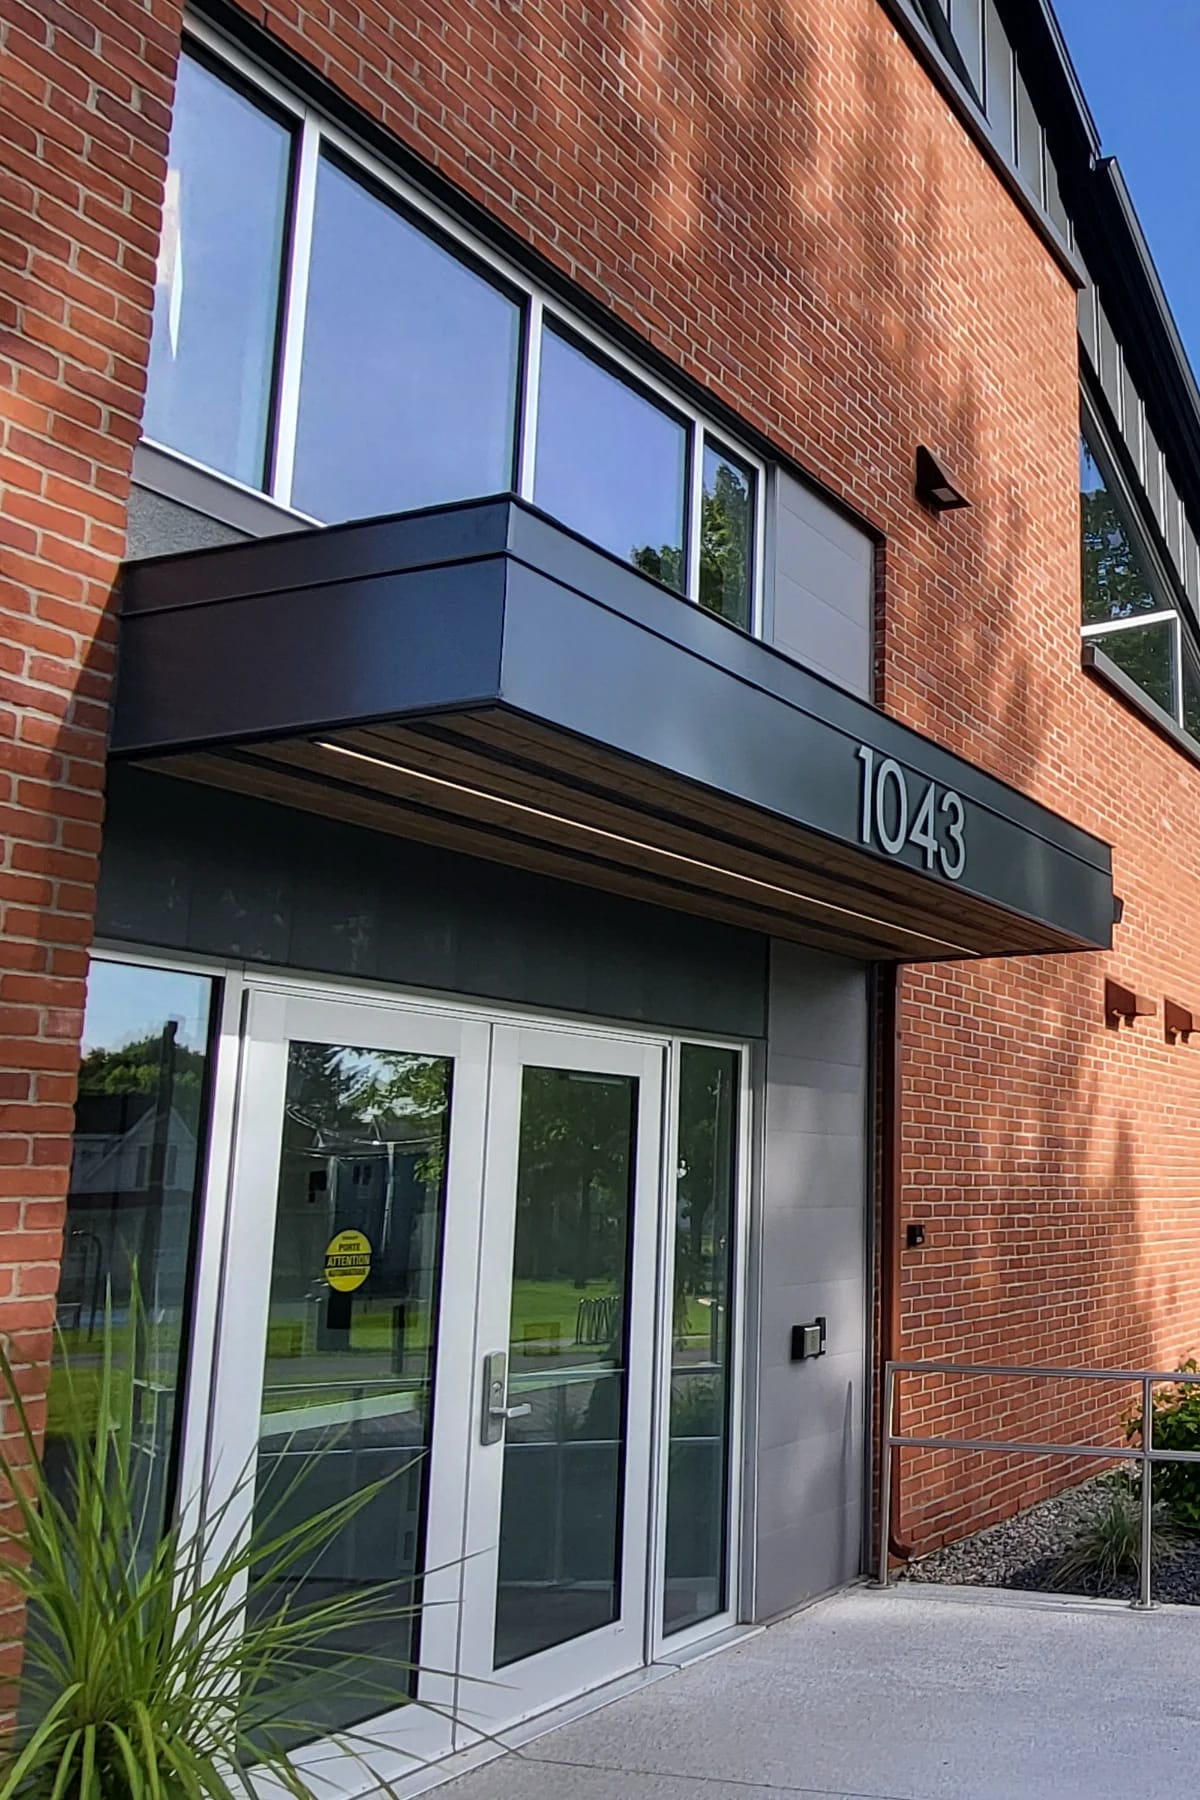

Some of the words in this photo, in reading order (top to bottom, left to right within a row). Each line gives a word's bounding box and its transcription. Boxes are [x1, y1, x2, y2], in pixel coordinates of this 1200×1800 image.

[858, 745, 966, 879] 1043
[338, 1243, 360, 1252] PORTE
[327, 1255, 370, 1267] ATTENTION
